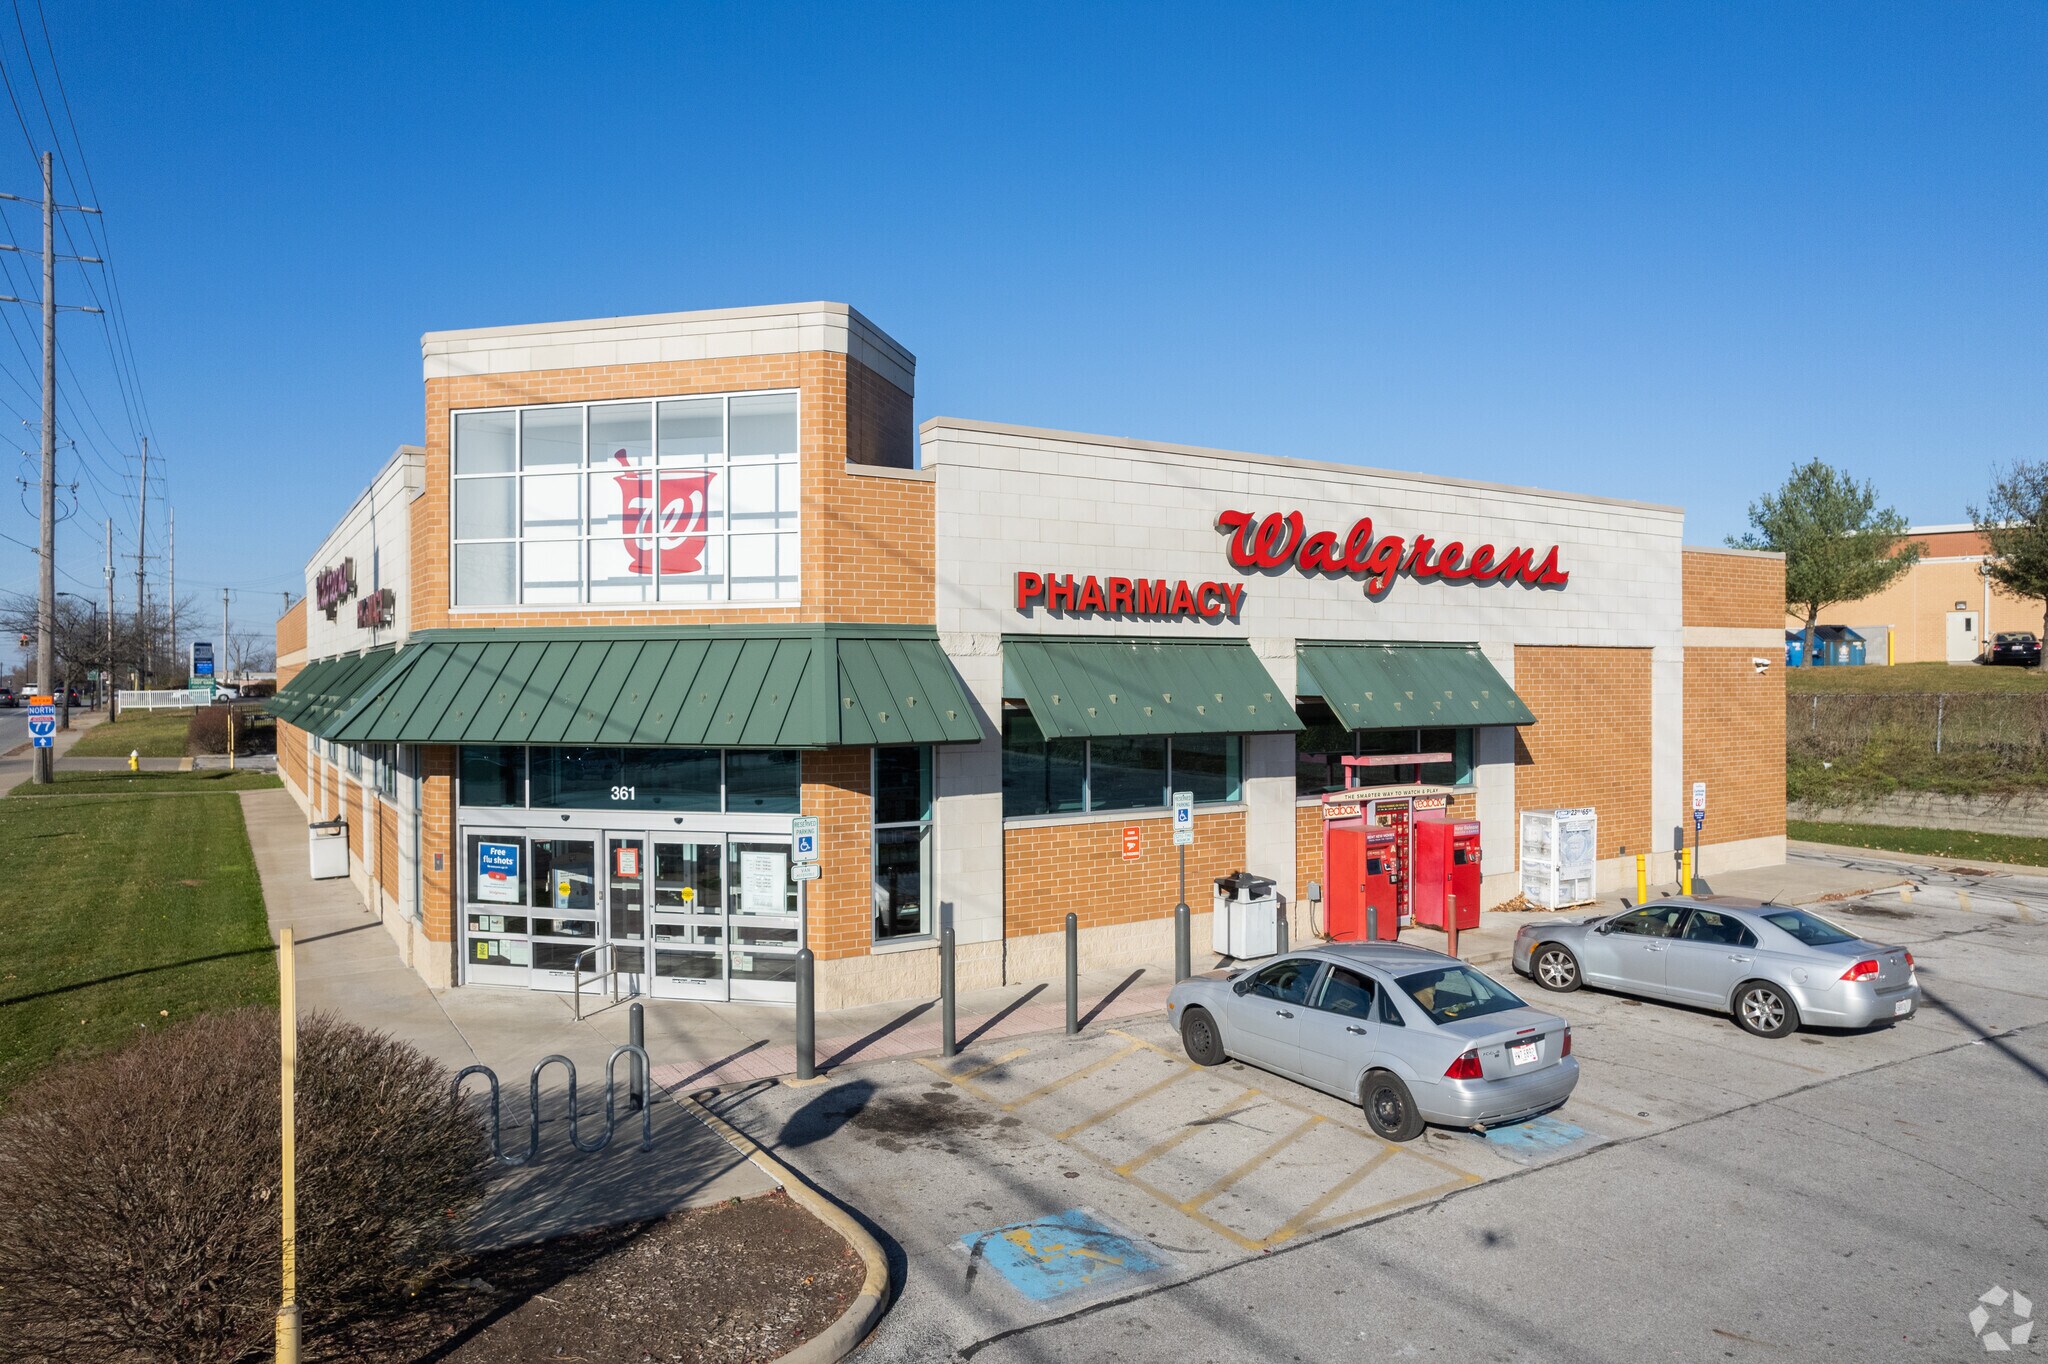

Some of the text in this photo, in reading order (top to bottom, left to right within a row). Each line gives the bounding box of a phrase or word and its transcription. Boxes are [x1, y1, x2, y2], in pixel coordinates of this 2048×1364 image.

[1215, 510, 1570, 595] Walgreens
[1015, 571, 1244, 618] PHARMACY
[29, 706, 54, 714] NORTH
[32, 721, 52, 732] 77
[611, 786, 635, 800] 361
[490, 847, 506, 856] Free
[482, 855, 493, 863] flu
